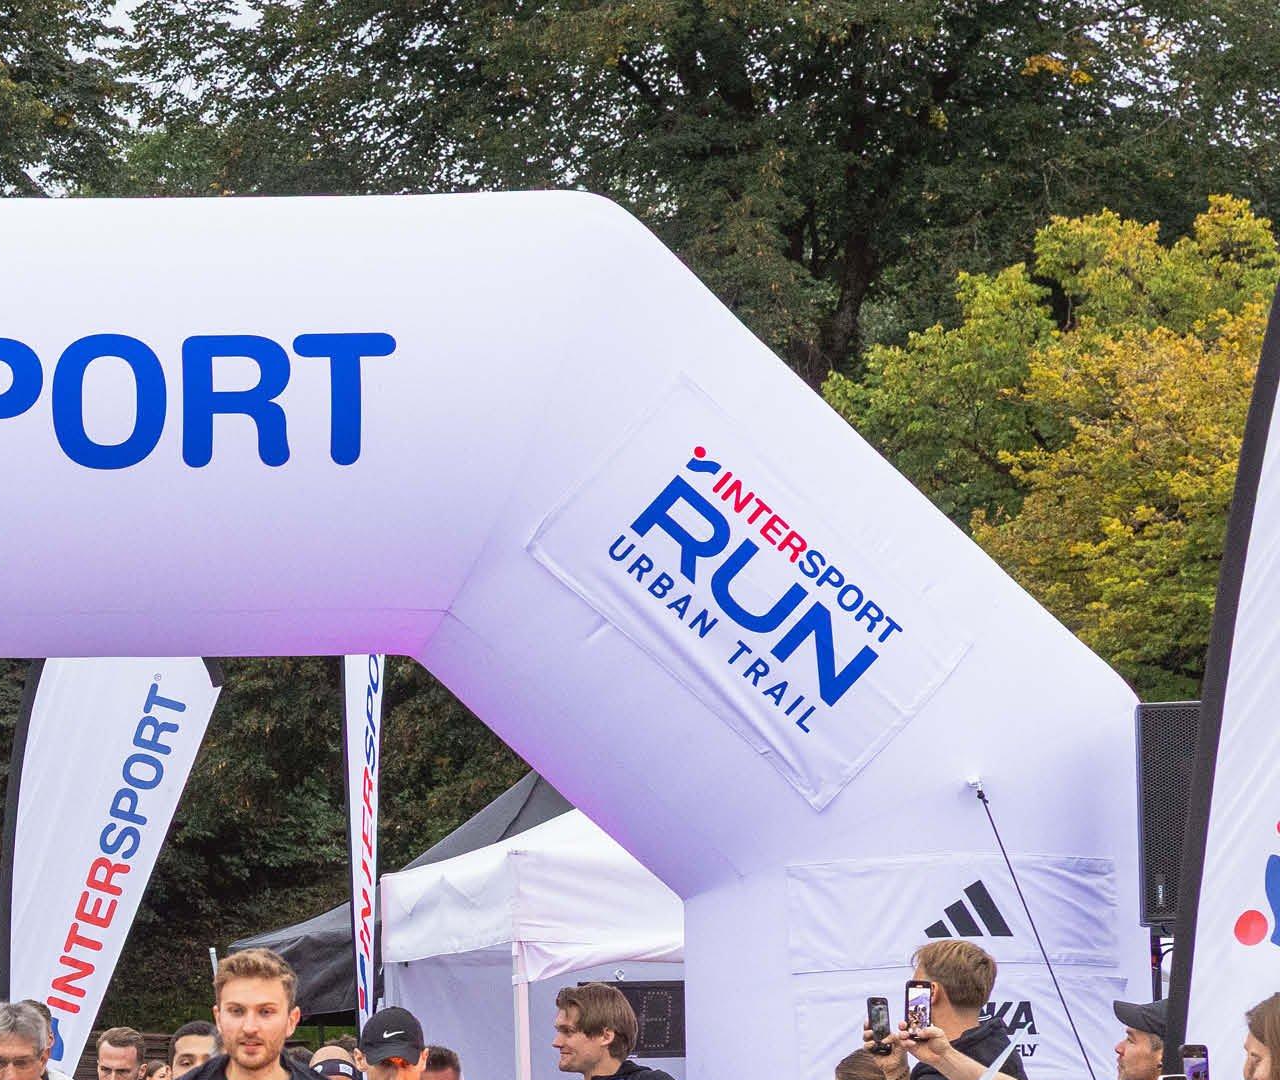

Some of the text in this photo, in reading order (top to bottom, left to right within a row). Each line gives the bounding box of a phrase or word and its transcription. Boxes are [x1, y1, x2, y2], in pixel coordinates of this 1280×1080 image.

[608, 534, 817, 734] URBAN TRAIL
[630, 474, 879, 707] RUN
[712, 471, 903, 643] INTERSPORT
